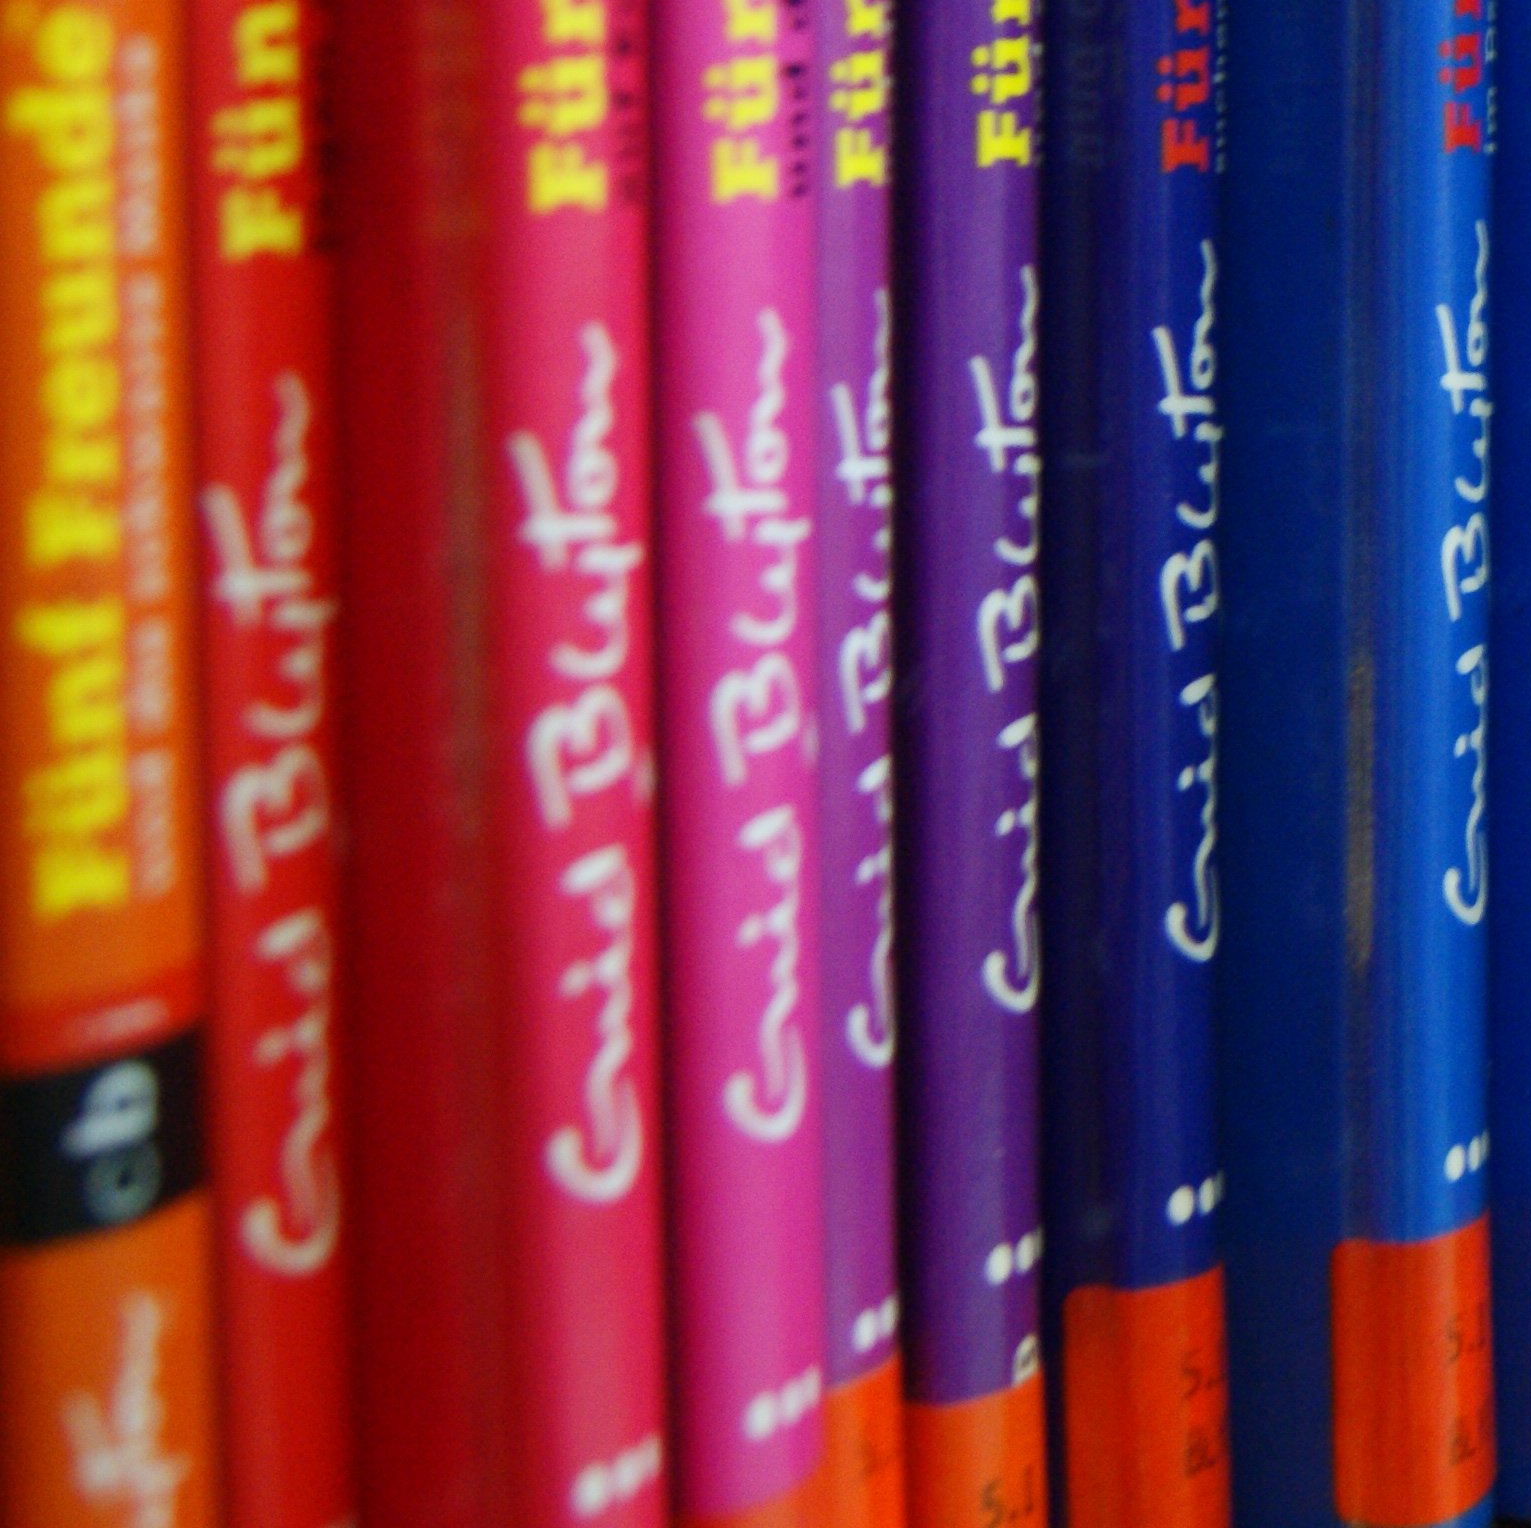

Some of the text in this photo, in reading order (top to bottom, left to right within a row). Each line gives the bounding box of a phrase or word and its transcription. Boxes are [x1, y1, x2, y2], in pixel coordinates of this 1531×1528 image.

[10, 6, 129, 919] Fünf Freunde
[848, 754, 895, 1067] Enid
[984, 712, 1040, 1013] Enid
[1167, 674, 1220, 960] Enid
[1443, 643, 1489, 925] Enid
[241, 909, 341, 1275] Enid
[545, 845, 642, 1205] Enid
[725, 806, 806, 1141] Enid
